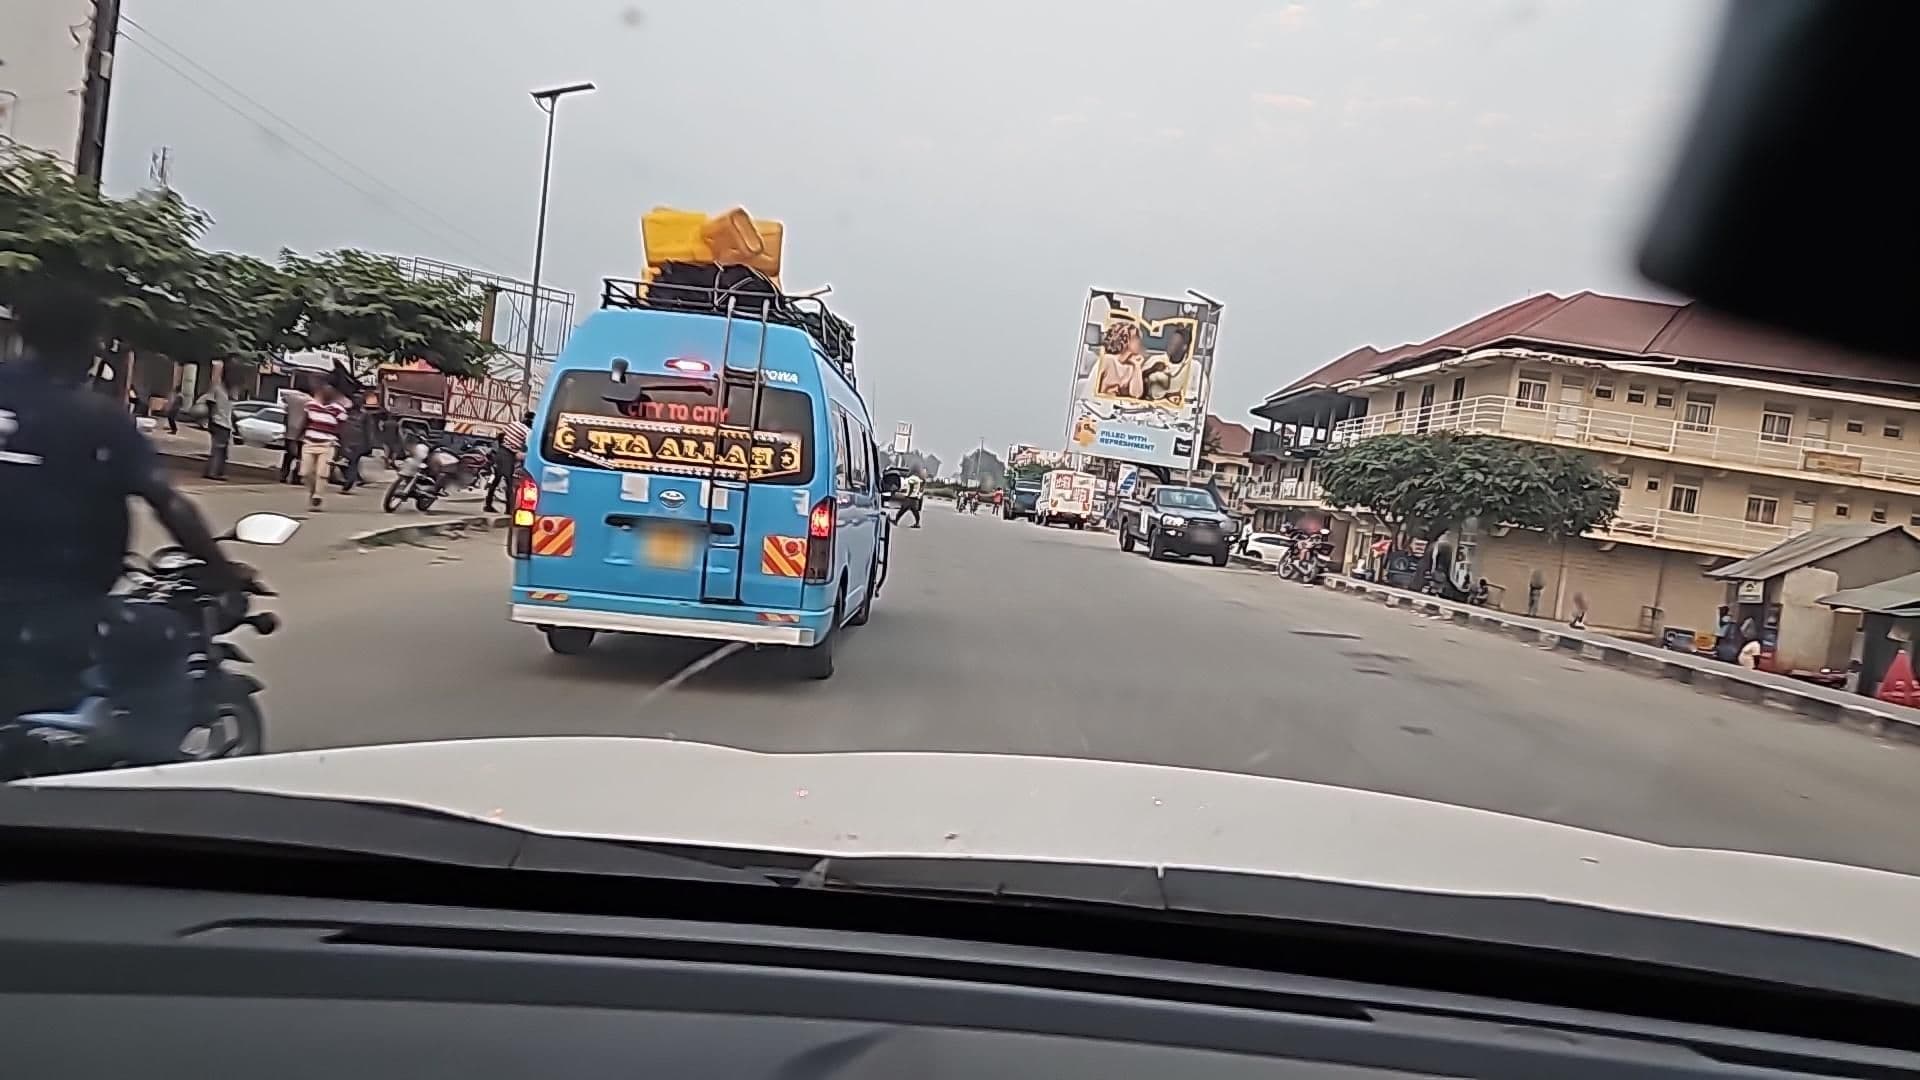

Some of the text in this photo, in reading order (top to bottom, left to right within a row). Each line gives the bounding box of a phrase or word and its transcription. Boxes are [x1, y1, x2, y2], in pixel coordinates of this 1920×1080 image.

[628, 401, 729, 424] CITY TO CITY
[1099, 437, 1155, 451] REFRESHMENT
[1100, 430, 1148, 443] FILLED WITH
[655, 437, 774, 469] ALLAH
